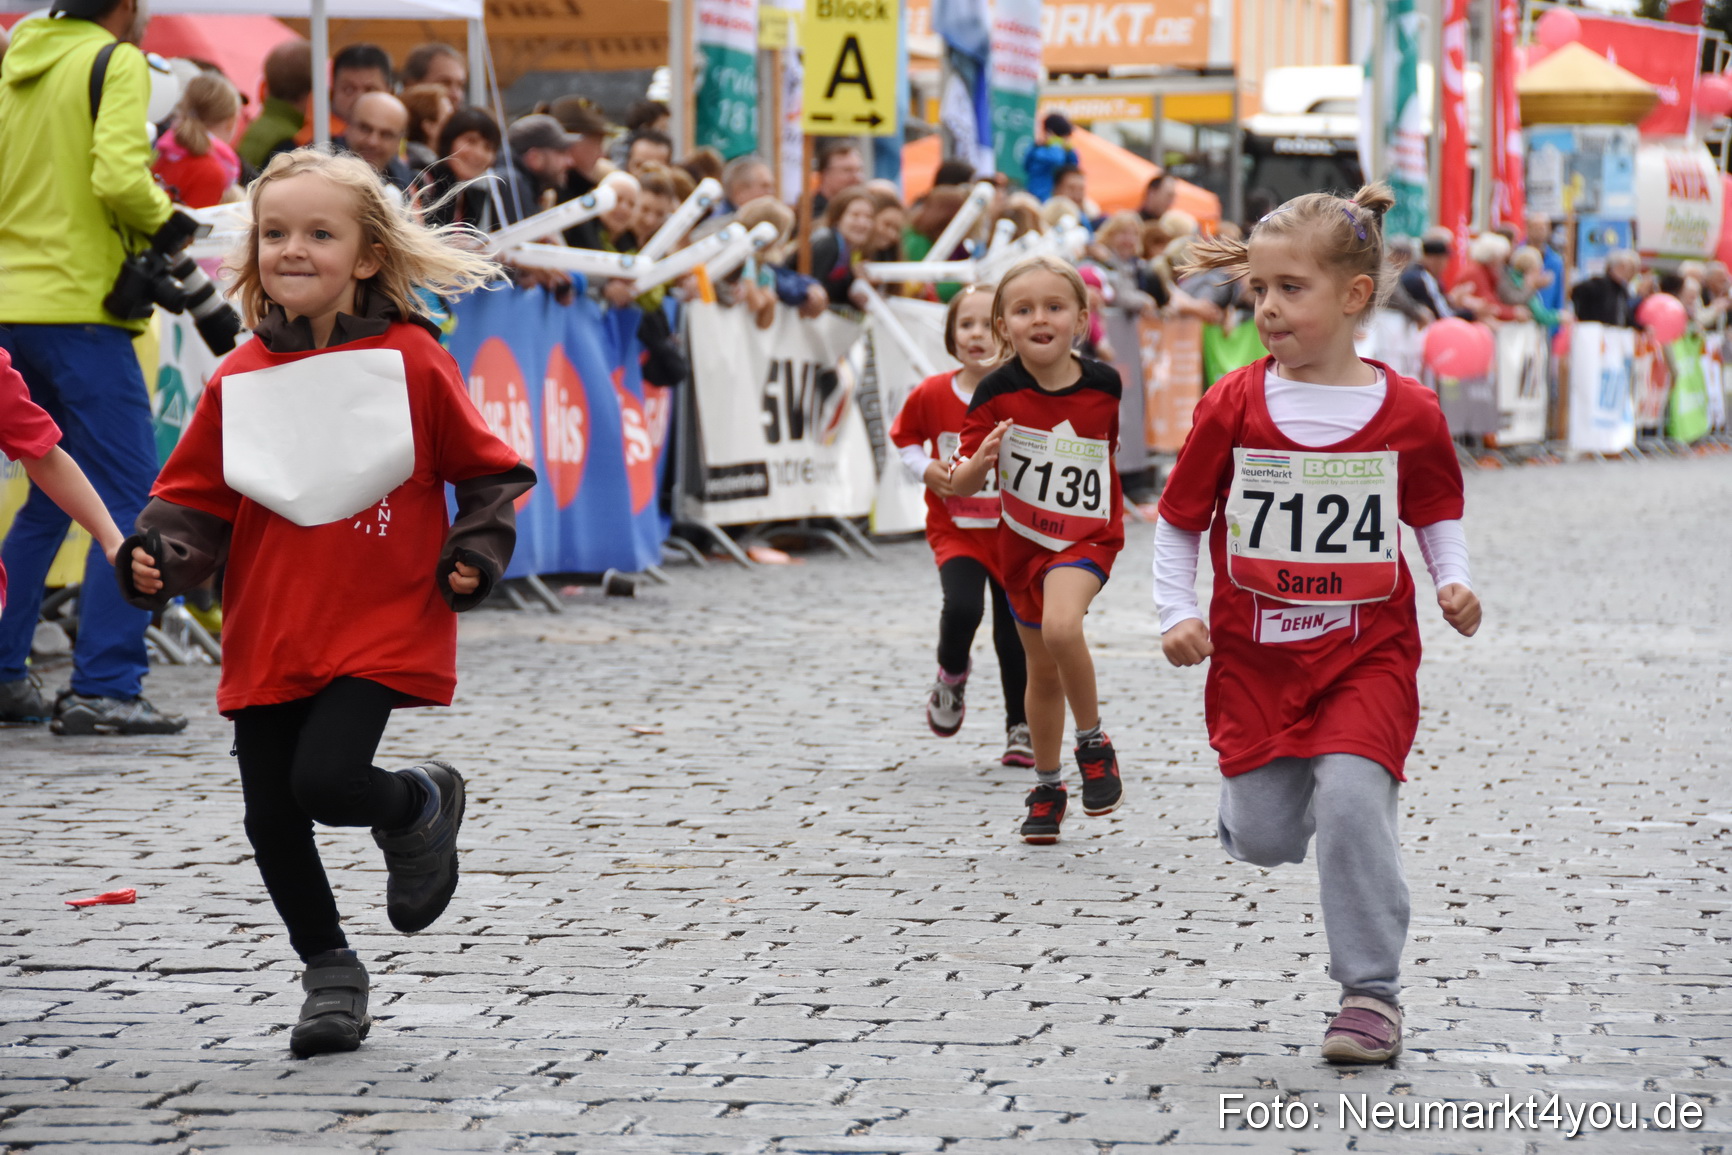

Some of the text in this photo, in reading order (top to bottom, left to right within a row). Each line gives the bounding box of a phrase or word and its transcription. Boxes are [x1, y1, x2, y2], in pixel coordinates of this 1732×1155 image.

[816, 0, 888, 20] Block
[825, 34, 874, 100] A
[1055, 438, 1104, 459] BOCK
[1241, 467, 1292, 479] NeuerMarkt
[1303, 458, 1384, 477] BOCK
[1011, 452, 1101, 511] 7139
[1302, 479, 1329, 487] inspired
[1032, 512, 1065, 535] Leni
[1243, 490, 1385, 553] 7124
[1234, 543, 1238, 553] 1
[1386, 549, 1392, 559] K
[1277, 569, 1342, 594] Sarah
[1281, 612, 1325, 632] DEHN
